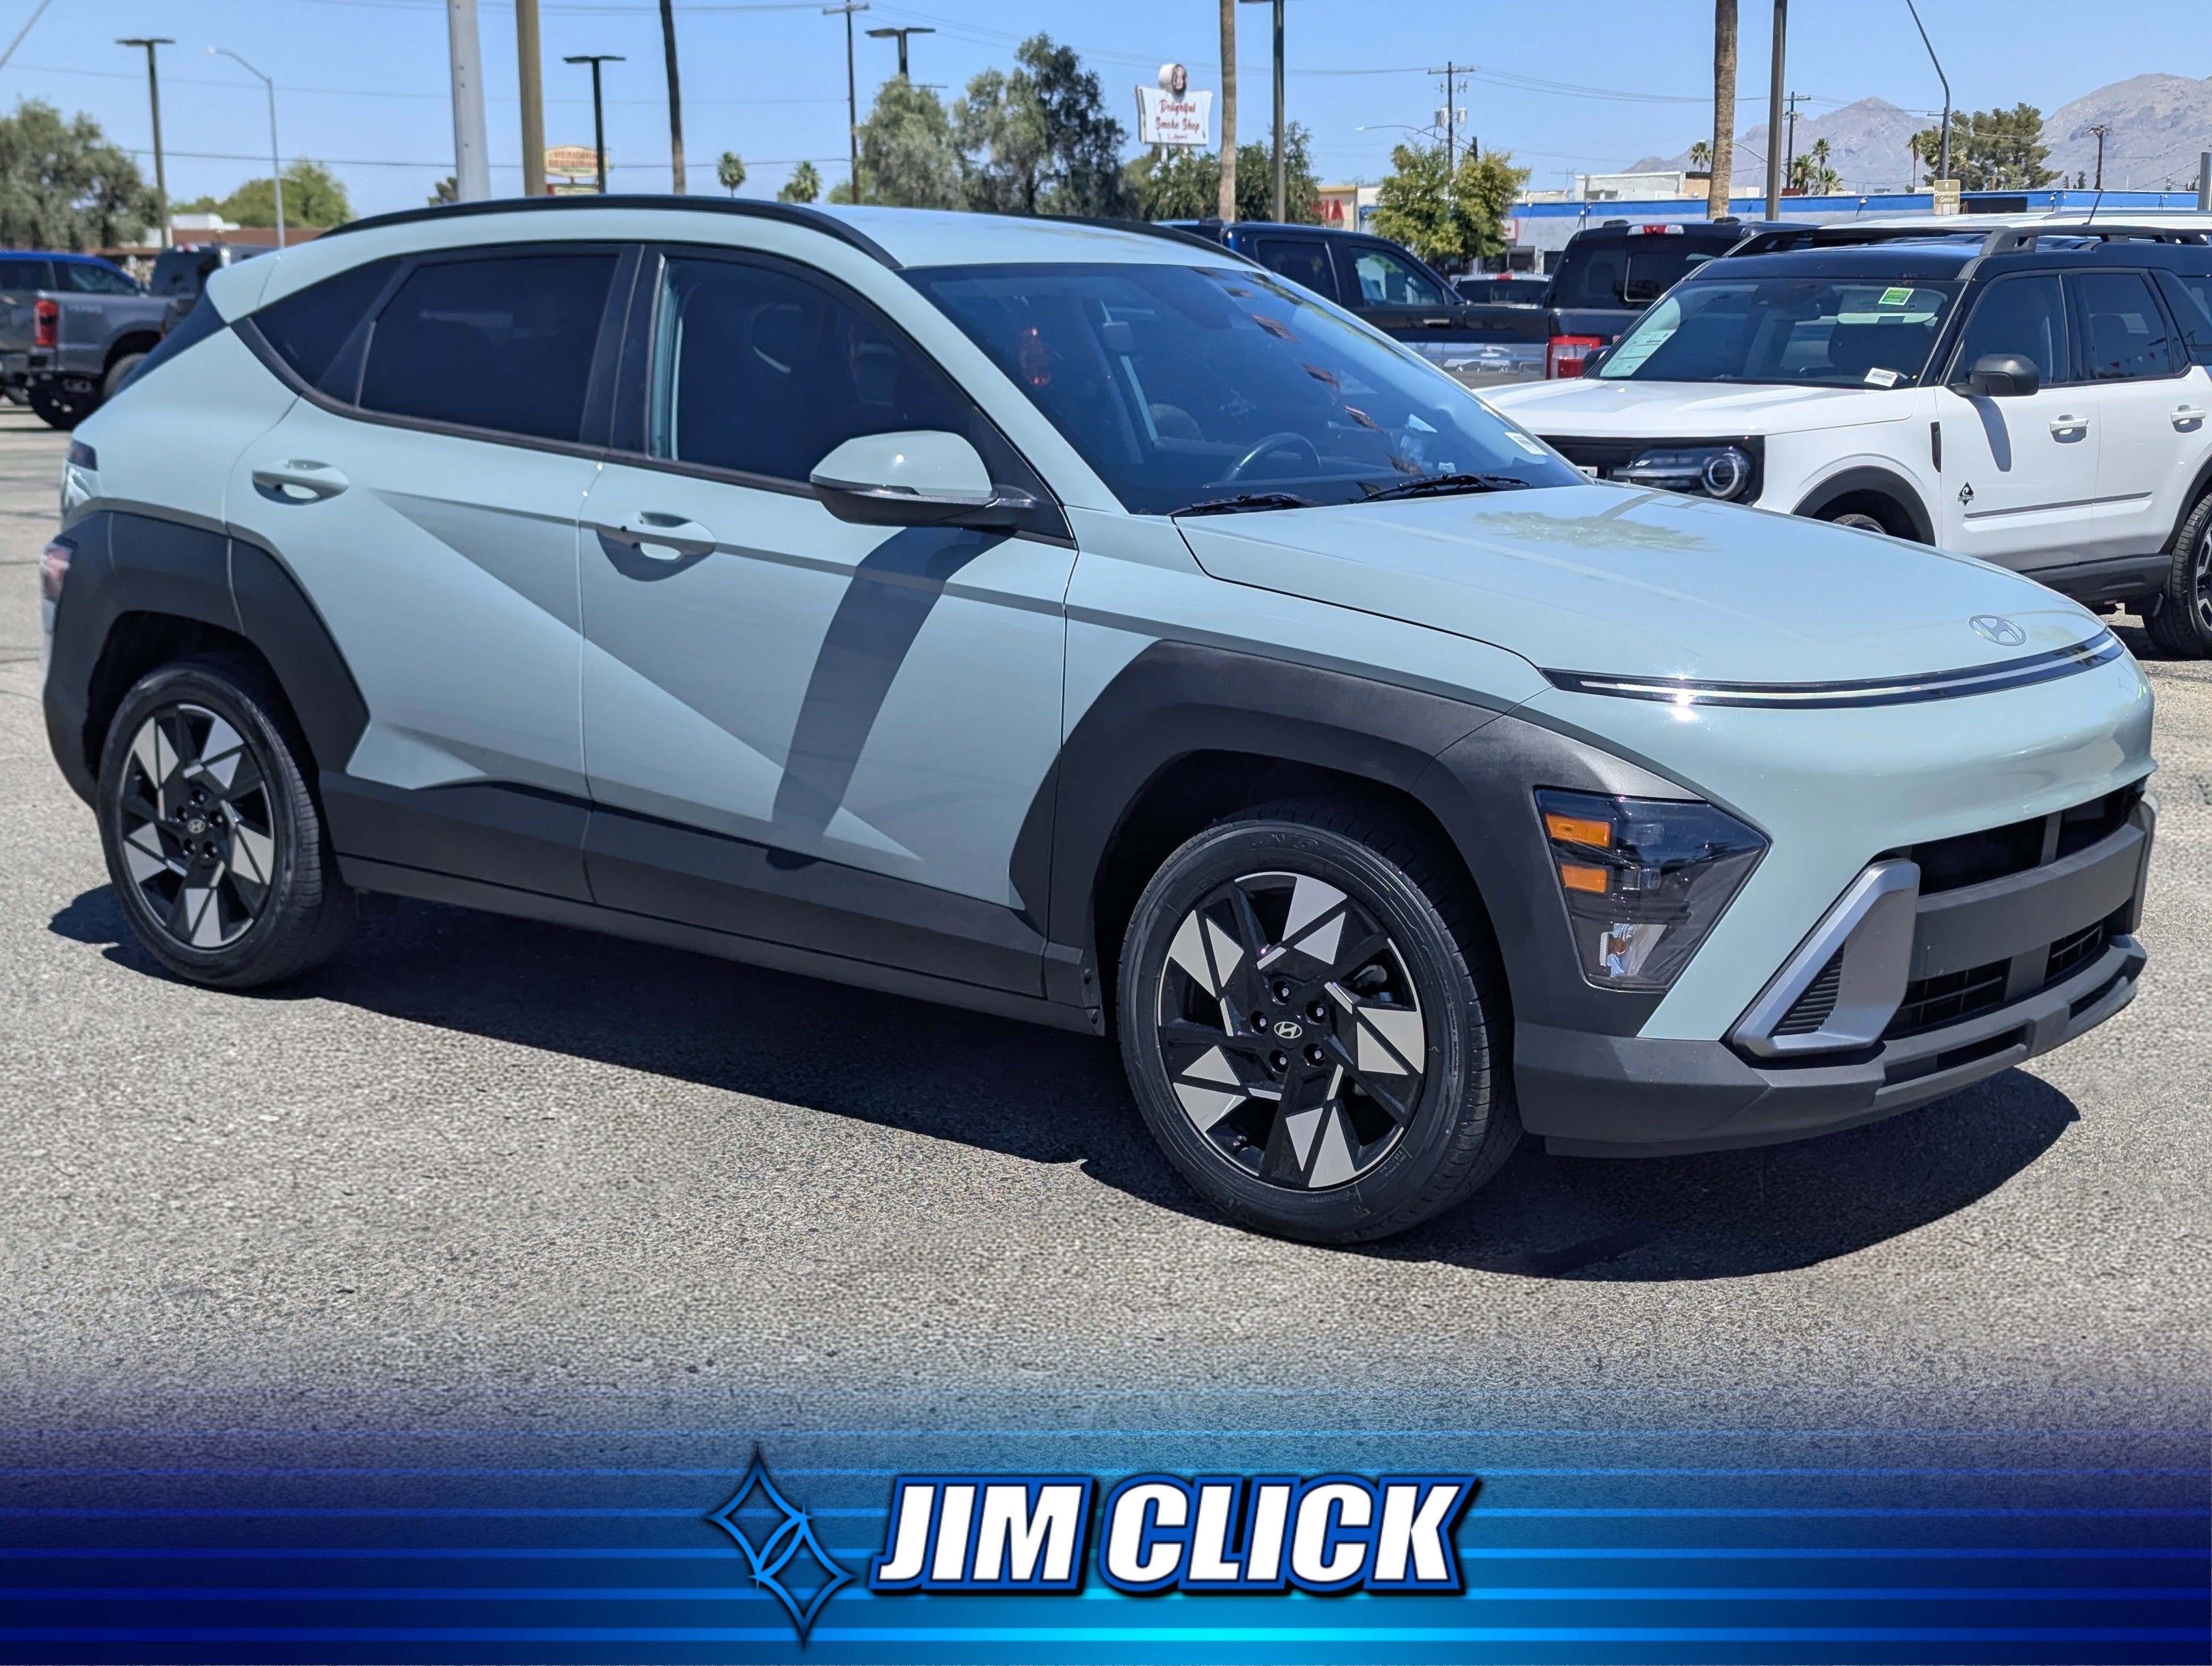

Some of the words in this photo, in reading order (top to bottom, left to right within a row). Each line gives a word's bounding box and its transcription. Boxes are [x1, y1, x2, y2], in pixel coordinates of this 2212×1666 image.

[1159, 98, 1197, 116] Delightful
[1155, 116, 1179, 131] Smoke
[1182, 117, 1200, 133] Shop
